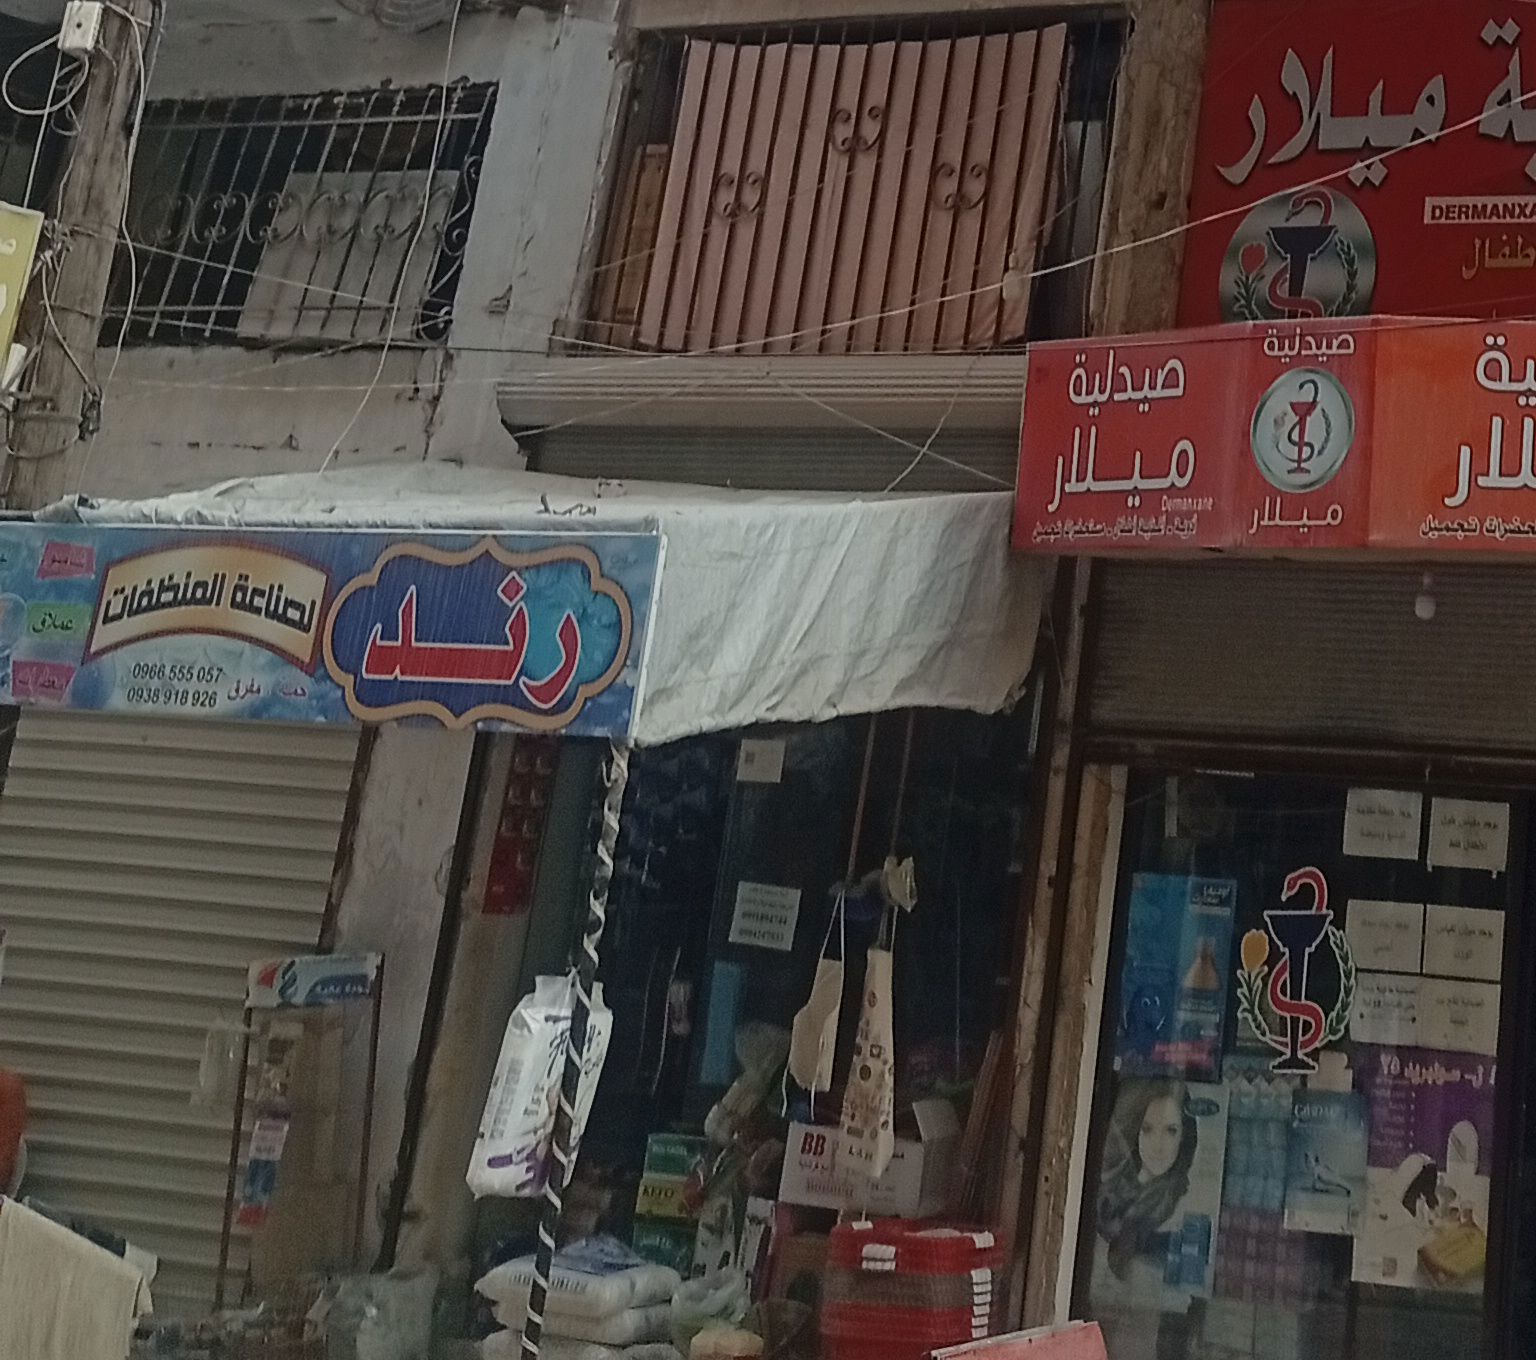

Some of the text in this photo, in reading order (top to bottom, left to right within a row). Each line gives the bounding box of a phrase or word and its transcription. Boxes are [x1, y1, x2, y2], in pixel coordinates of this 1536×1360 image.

[1215, 43, 1448, 189] ميلار
[1264, 327, 1356, 364] صيدلية
[1068, 347, 1187, 418] صيدلية
[1046, 422, 1197, 514] ميلار
[1248, 495, 1344, 535] ميلار
[101, 569, 318, 635] لصناعة المنظفات
[168, 662, 195, 681] 555
[196, 664, 224, 684] 057
[363, 570, 582, 711] رند
[162, 688, 190, 707] 918
[191, 691, 218, 709] 926
